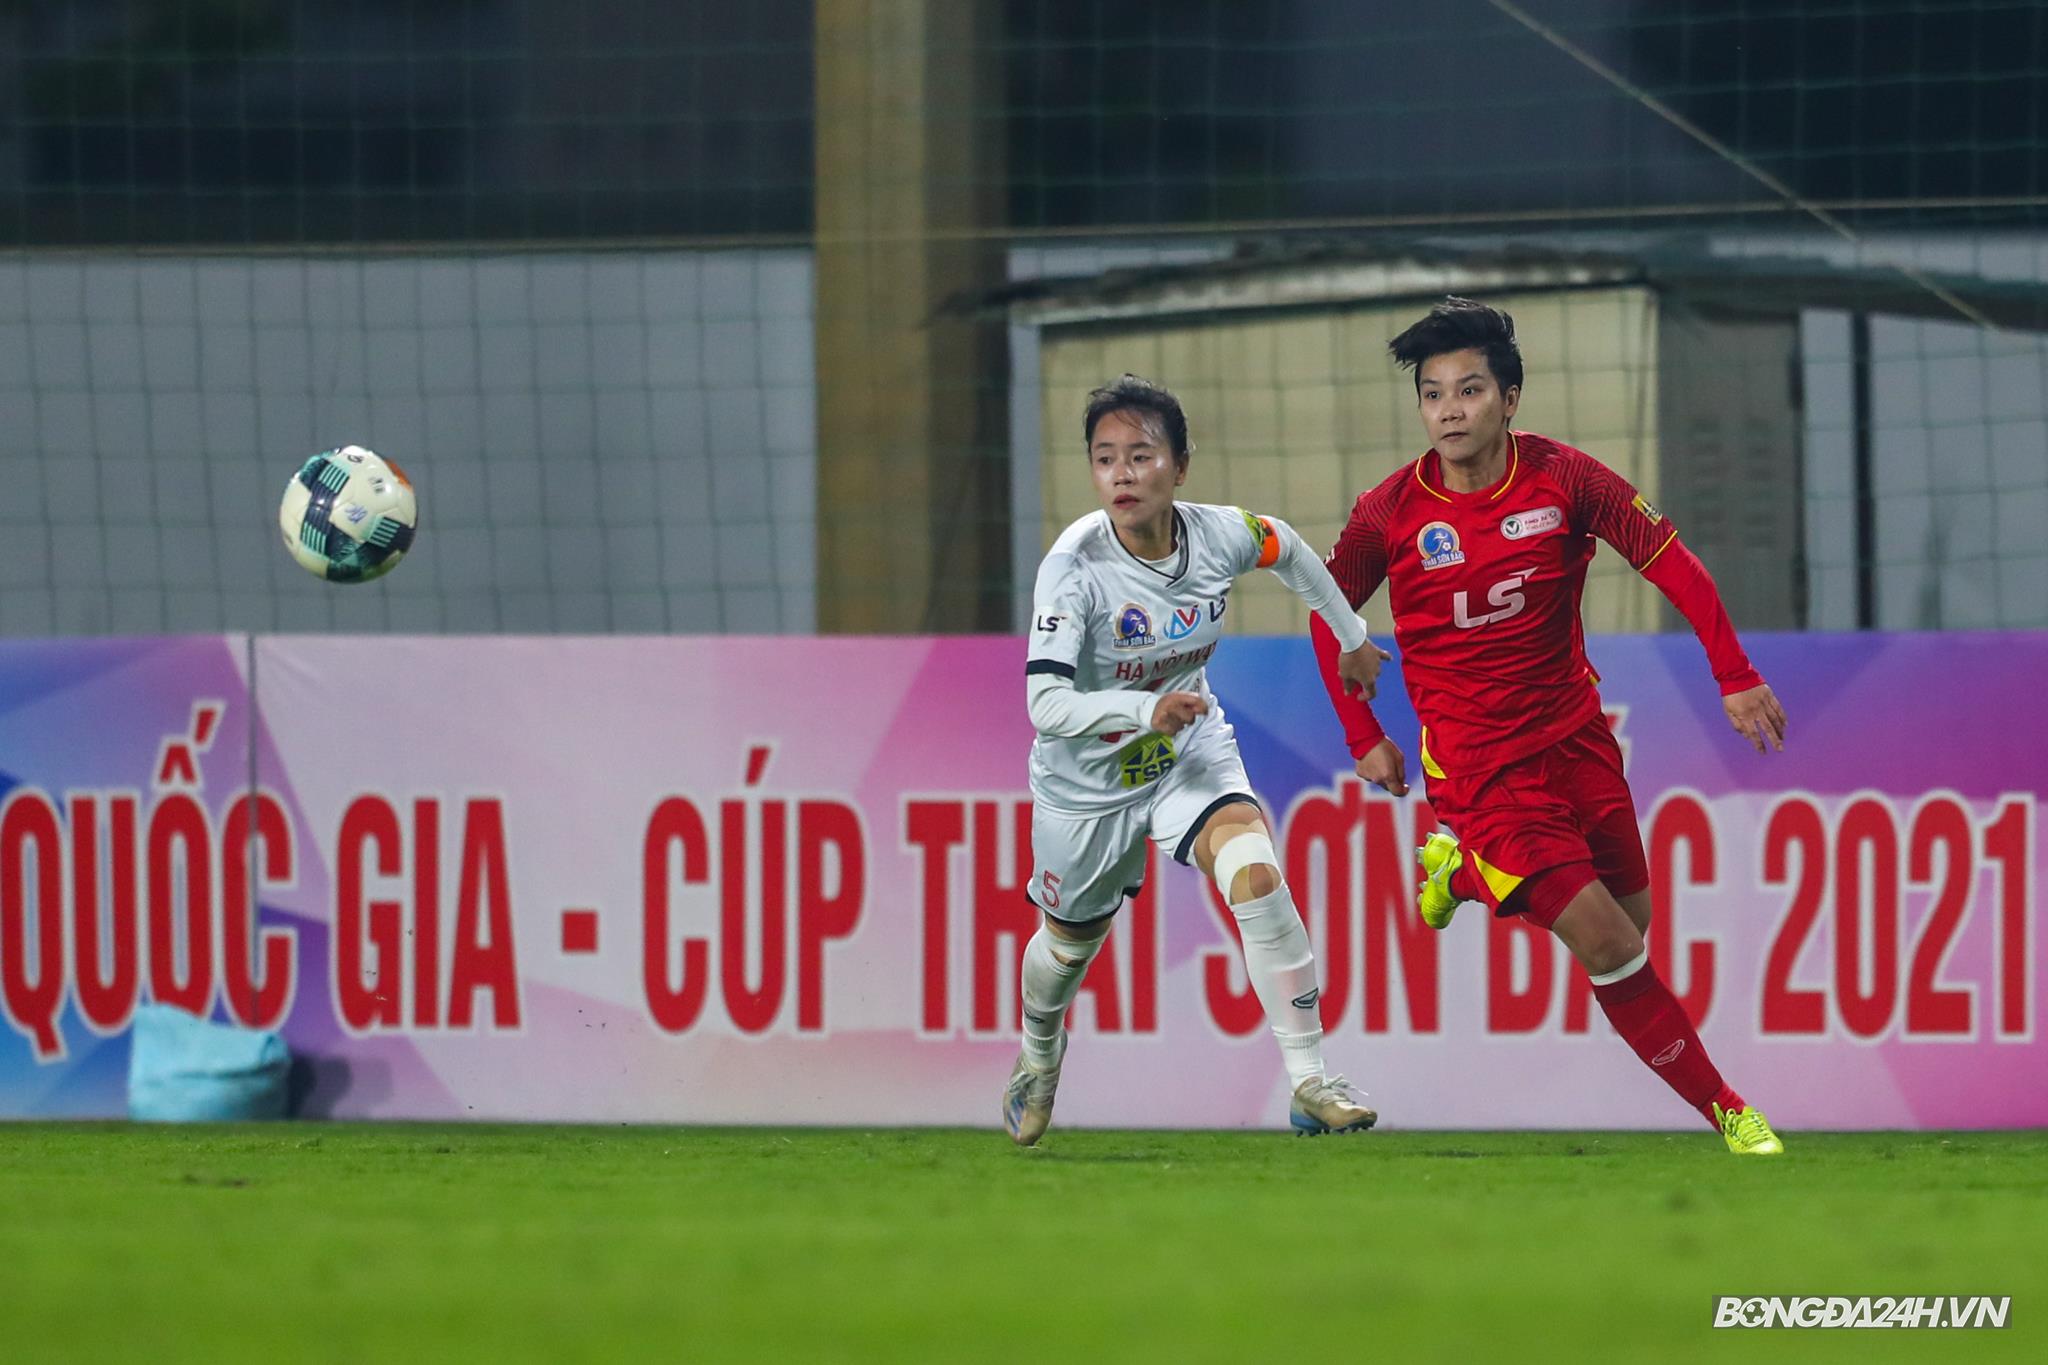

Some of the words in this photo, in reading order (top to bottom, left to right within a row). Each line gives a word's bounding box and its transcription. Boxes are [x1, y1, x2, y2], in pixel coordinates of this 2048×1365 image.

[1453, 574, 1527, 629] LS
[1037, 615, 1059, 632] LS
[1115, 656, 1144, 681] HÀ
[2, 709, 293, 1057] QUỐC
[338, 796, 521, 1029] GIA
[644, 747, 864, 1032] CÚP
[1761, 797, 2027, 1036] 2021
[1041, 870, 1061, 908] 5
